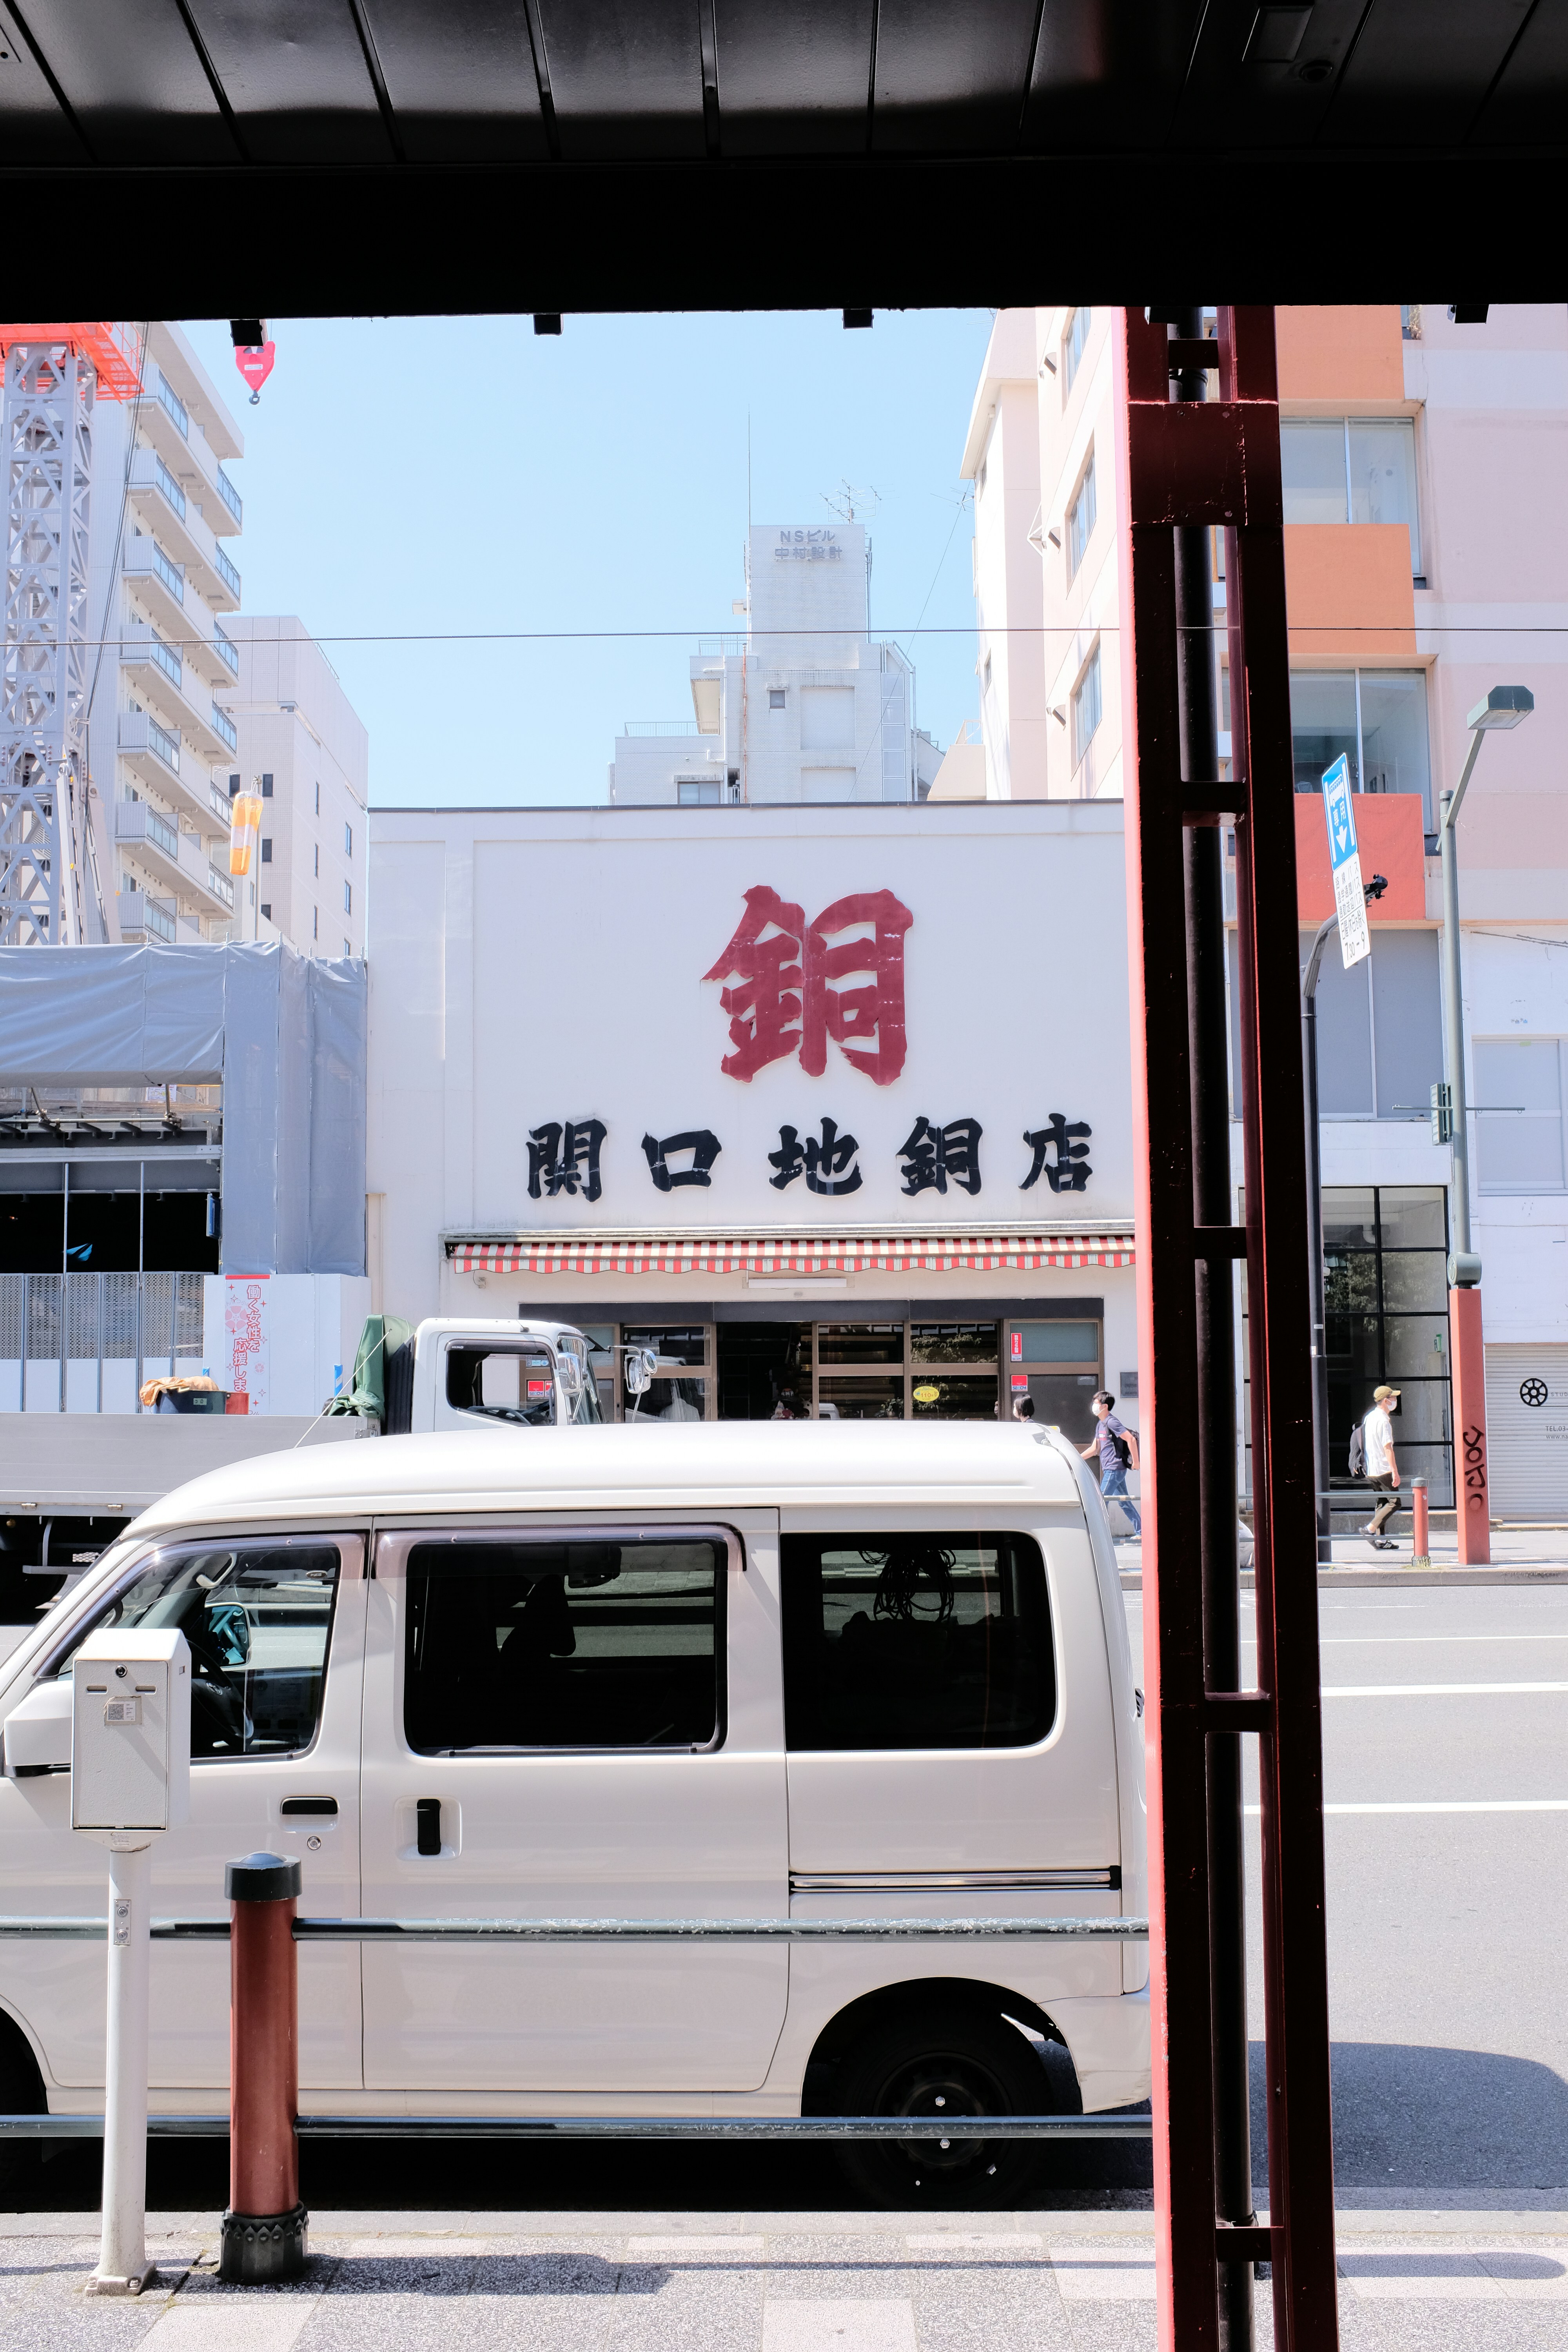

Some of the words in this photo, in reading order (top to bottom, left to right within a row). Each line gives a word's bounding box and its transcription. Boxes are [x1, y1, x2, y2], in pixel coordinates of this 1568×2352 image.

[775, 546, 842, 559] 中村設計
[780, 530, 835, 542] NSビル
[1333, 800, 1346, 827] 専用
[1336, 861, 1359, 889] 路線バス
[701, 884, 914, 1087] 銅
[525, 1112, 1093, 1203] 関口地銅店
[247, 1285, 261, 1352] 働く女性を
[233, 1338, 247, 1392] 応援しま
